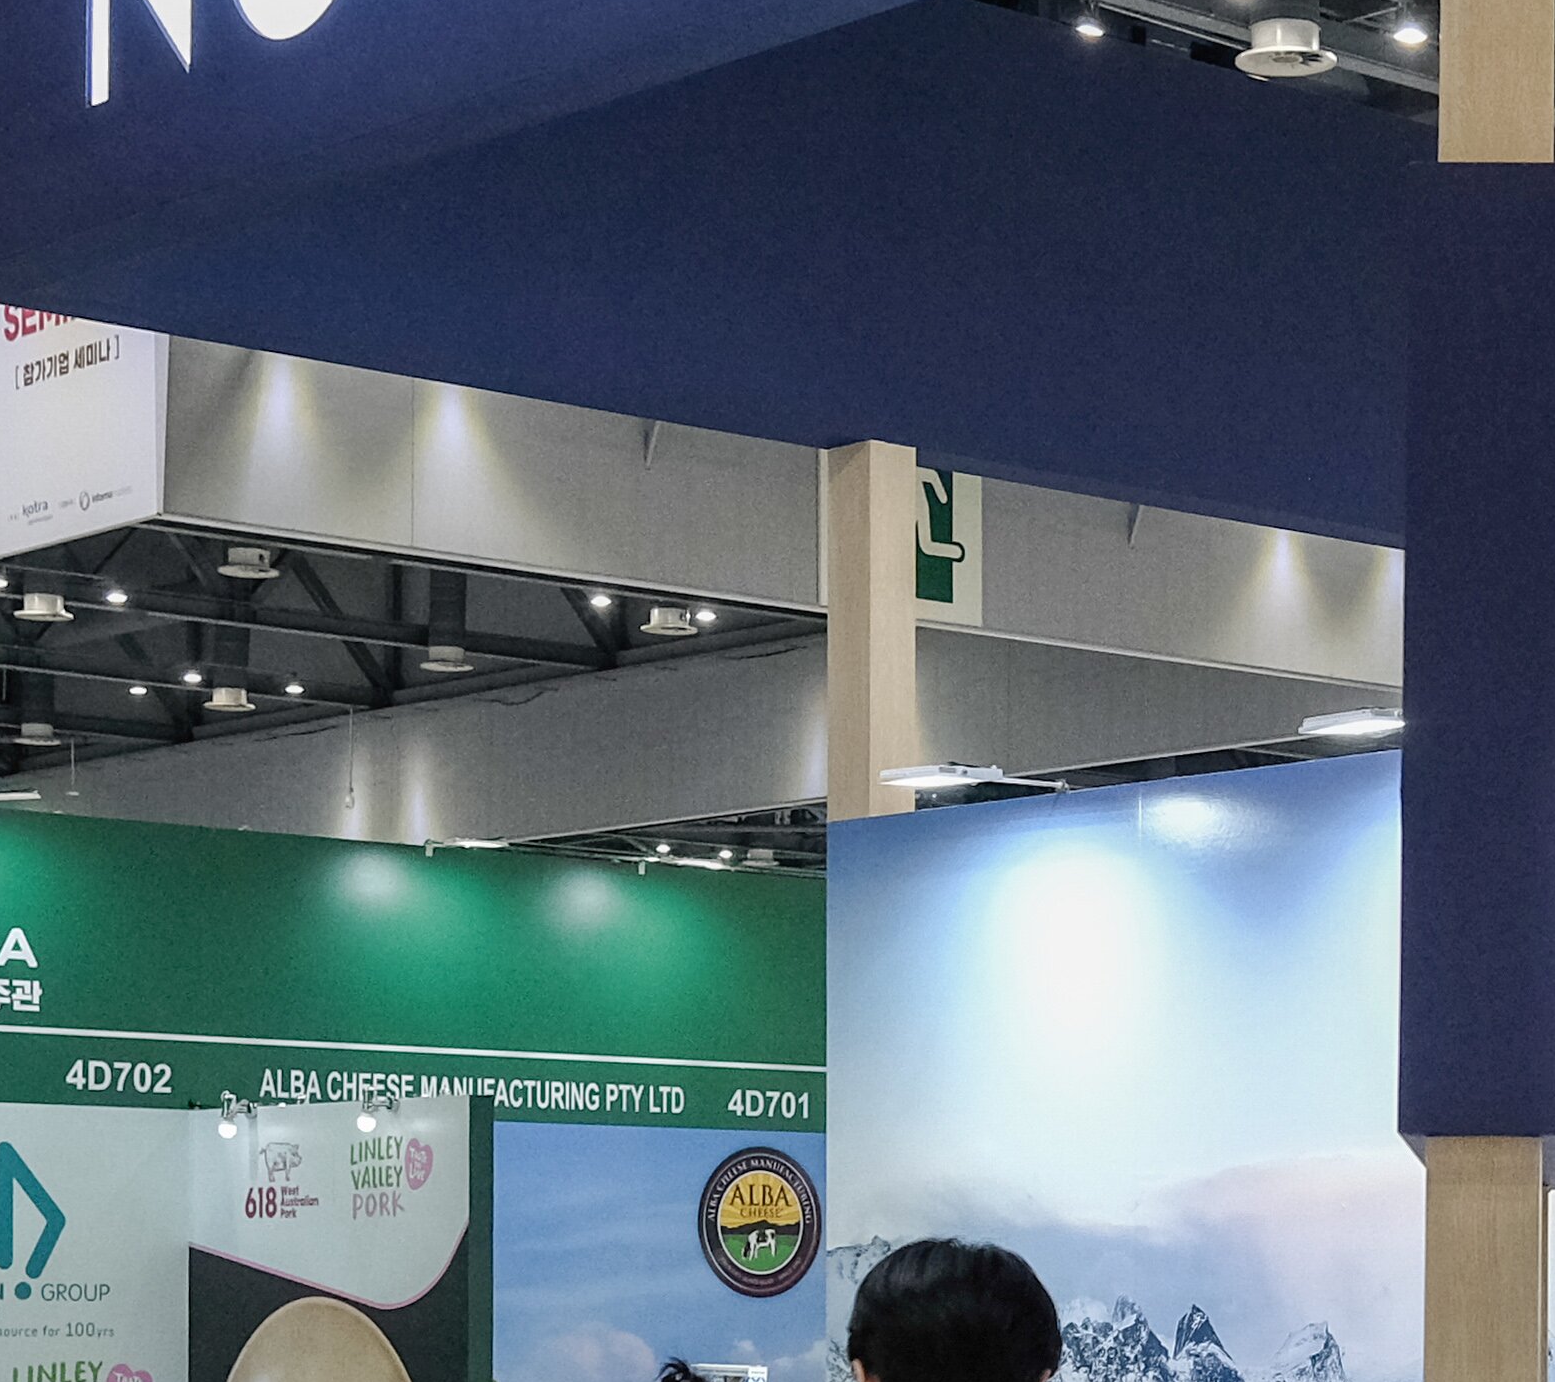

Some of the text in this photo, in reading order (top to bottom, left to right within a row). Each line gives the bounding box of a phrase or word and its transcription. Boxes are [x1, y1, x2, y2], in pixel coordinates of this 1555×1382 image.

[23, 337, 111, 387] 참가기업 세미나
[65, 1059, 173, 1095] 4D702
[260, 1069, 322, 1100] ALBA
[605, 1083, 644, 1112] PTY
[648, 1085, 685, 1114] LTD
[727, 1088, 811, 1120] 4D701
[350, 1136, 403, 1165] LINLEY
[351, 1166, 403, 1190] VALLEY
[245, 1186, 277, 1218] 618
[352, 1191, 405, 1219] PORK
[729, 1184, 792, 1207] ALBA
[740, 1207, 783, 1218] CHEESE
[41, 1282, 110, 1301] GROUP
[42, 1324, 61, 1338] for
